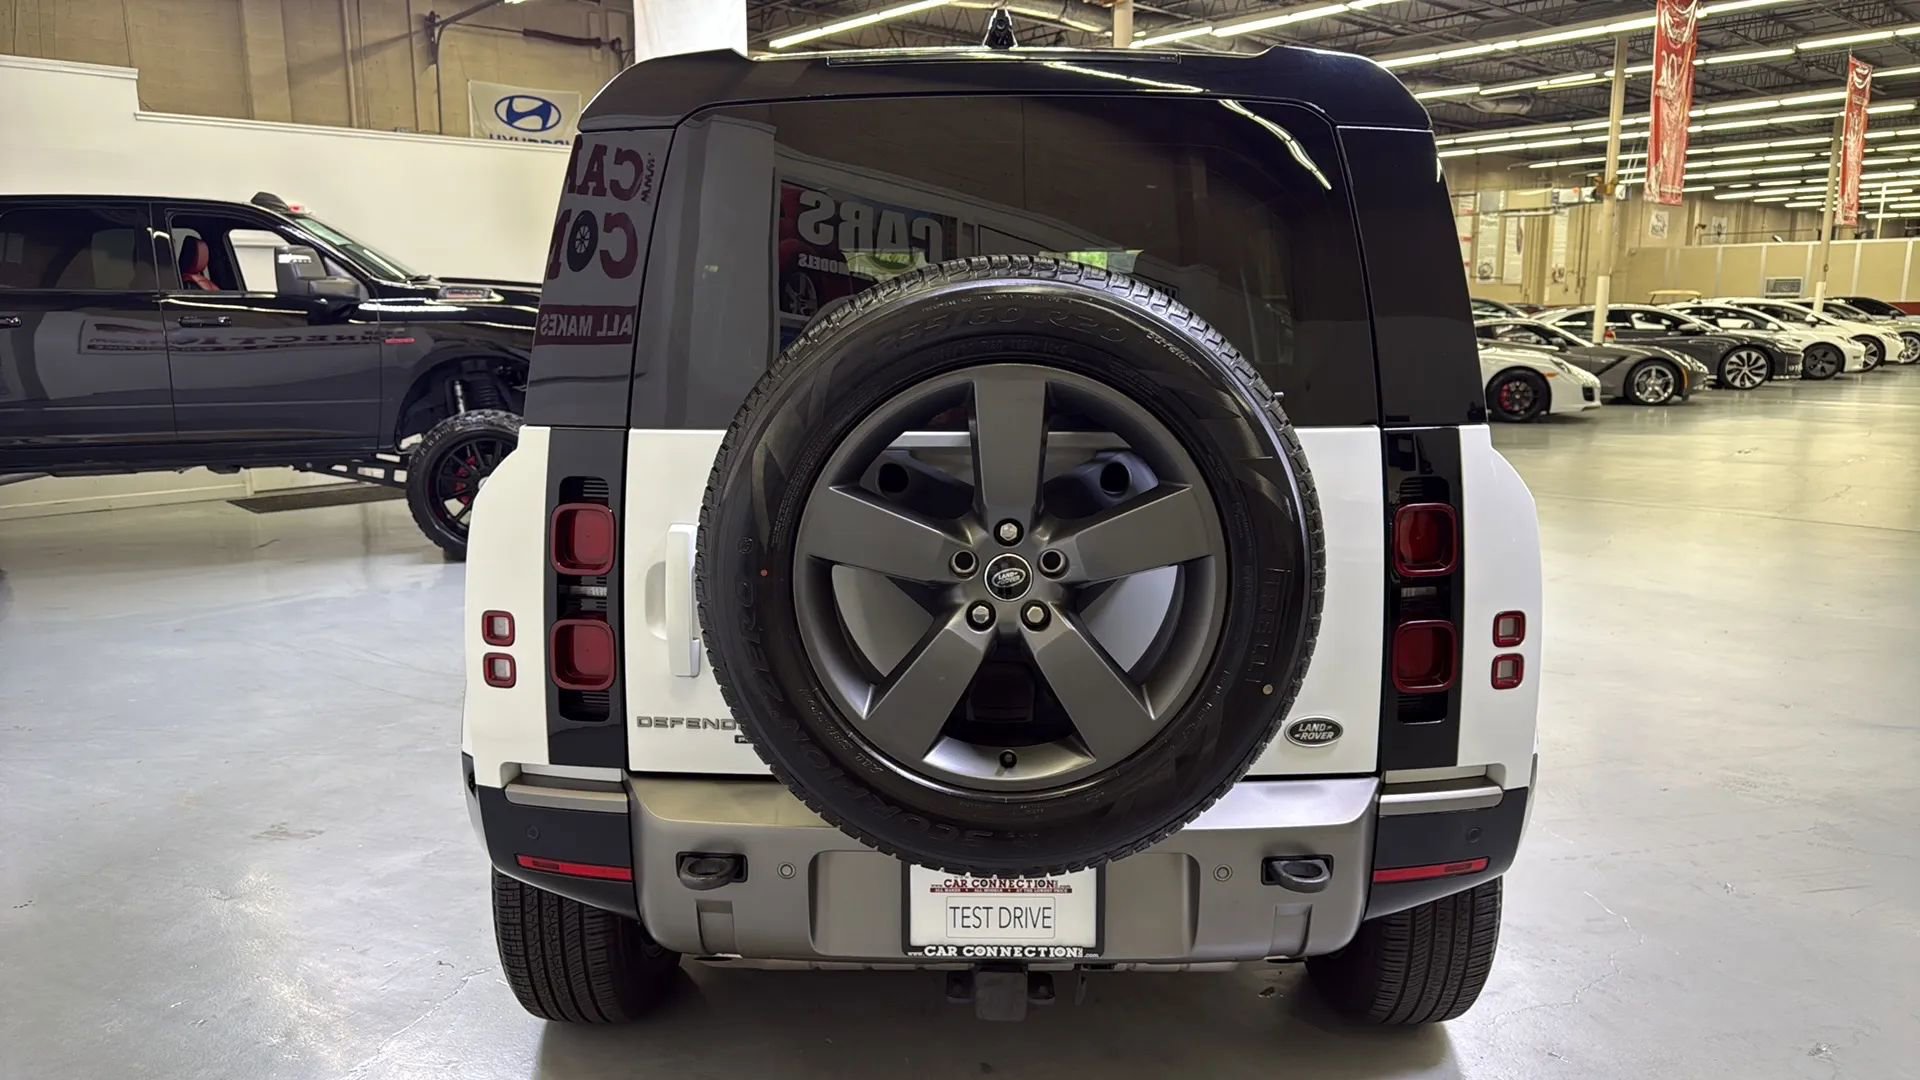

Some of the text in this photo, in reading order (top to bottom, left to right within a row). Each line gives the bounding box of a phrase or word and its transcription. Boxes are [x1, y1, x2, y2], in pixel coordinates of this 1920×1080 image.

[1298, 723, 1326, 732] LAND
[1300, 731, 1335, 740] ROVER
[943, 879, 968, 888] CAR
[972, 879, 1055, 889] CONNECTION
[949, 906, 1052, 929] TEST DRIVE
[924, 945, 958, 957] CAR
[963, 945, 1077, 957] CONNECTION
